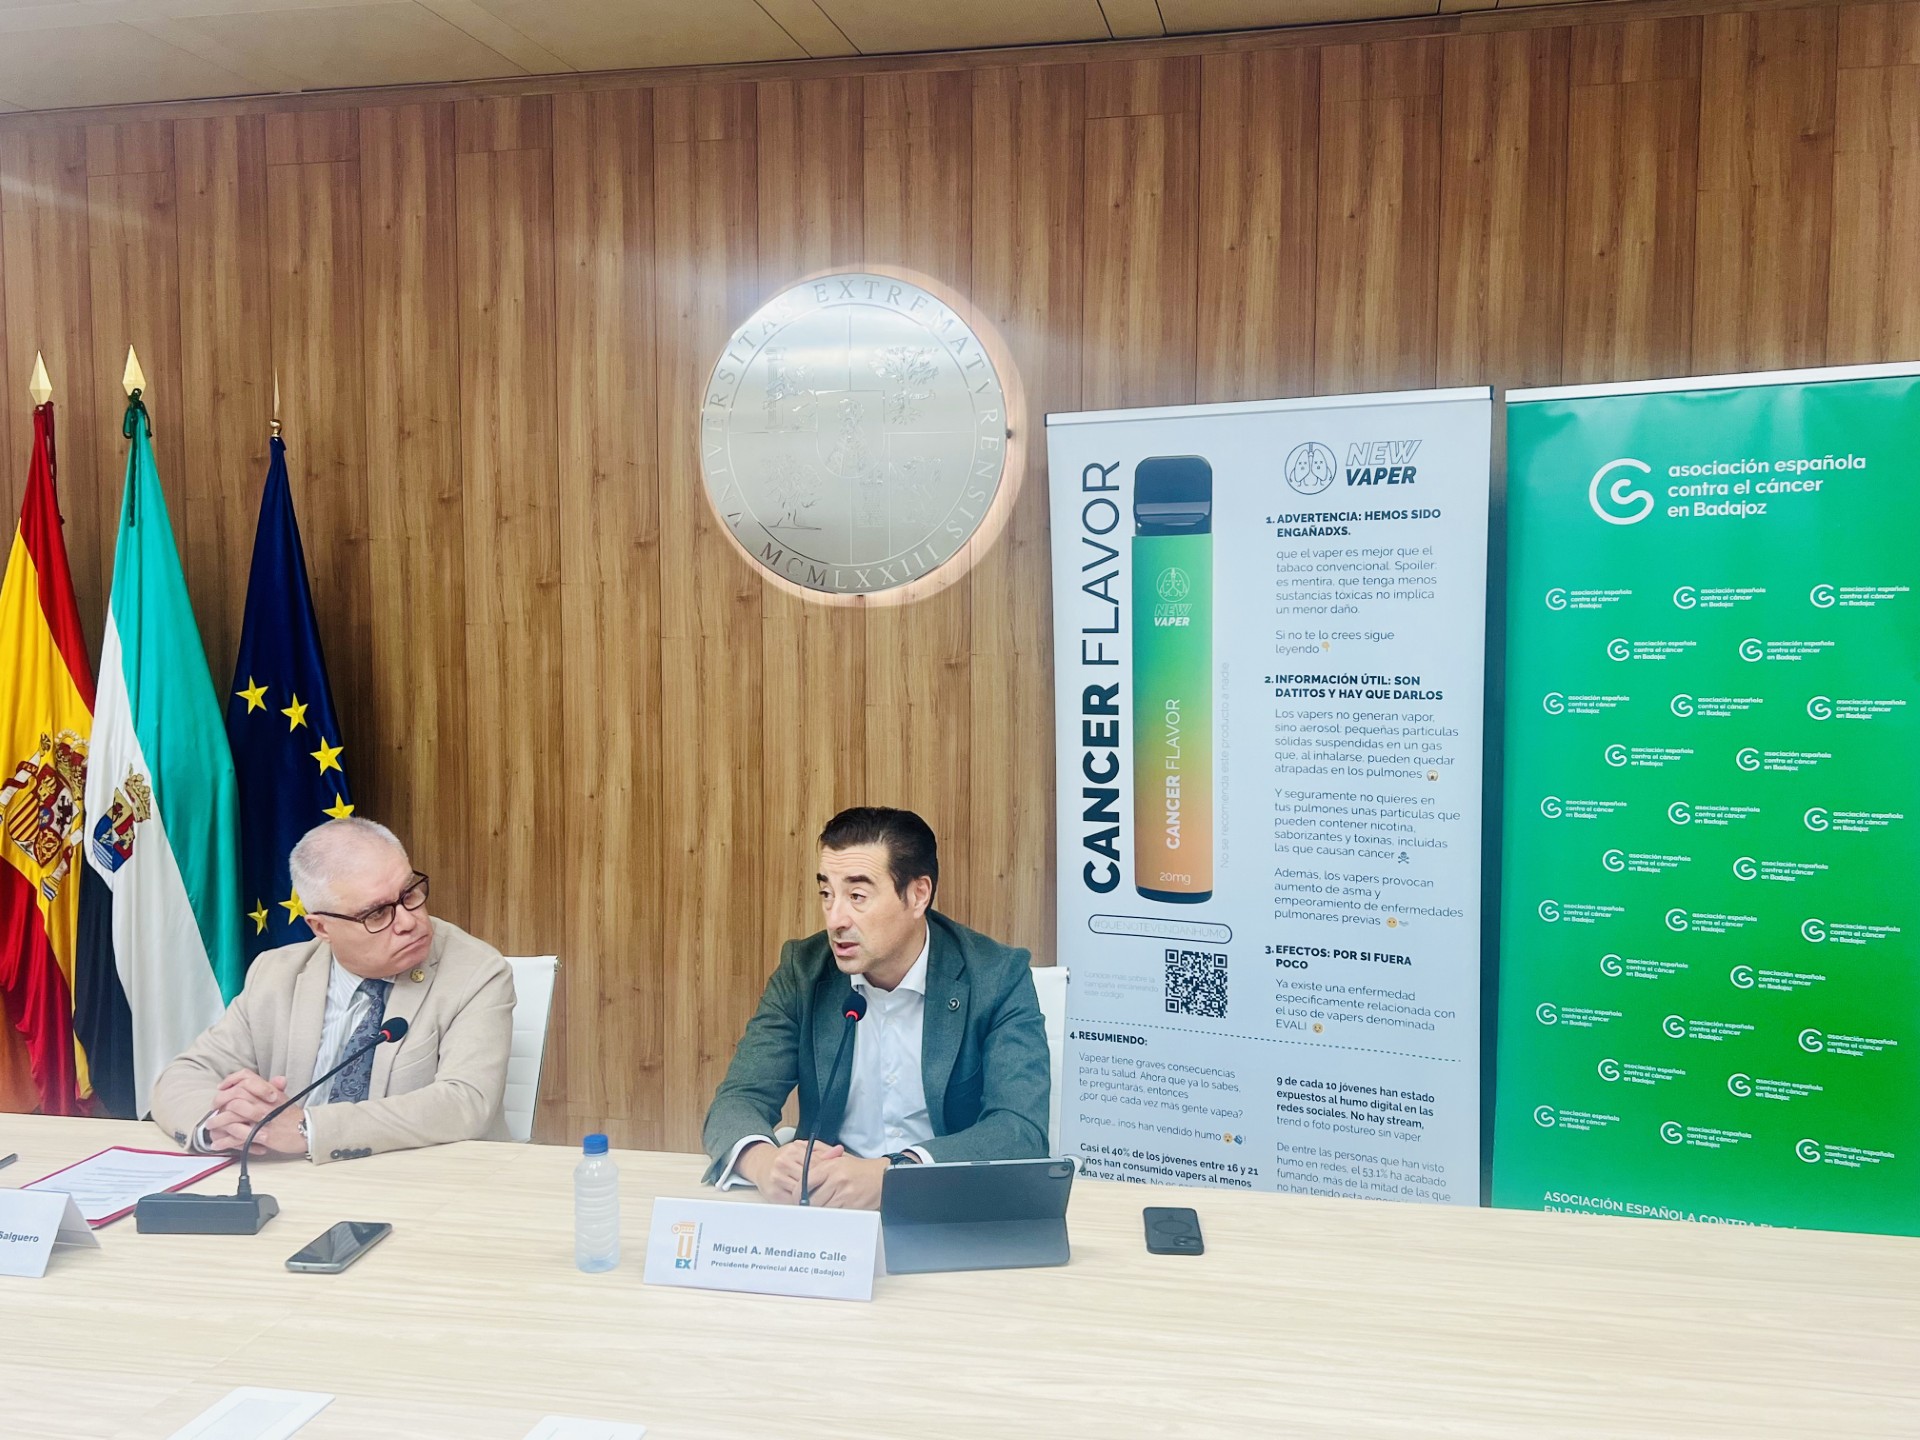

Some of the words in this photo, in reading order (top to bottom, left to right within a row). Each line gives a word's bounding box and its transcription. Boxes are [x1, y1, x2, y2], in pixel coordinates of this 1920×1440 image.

[1345, 440, 1422, 466] NEW
[1668, 458, 1770, 477] asociación
[1774, 454, 1867, 475] española
[1345, 466, 1417, 486] VAPER
[1667, 482, 1728, 498] contra
[1733, 479, 1751, 495] el
[1755, 477, 1823, 494] cáncer
[1276, 512, 1361, 523] ADVERTENCIA:
[1364, 510, 1408, 520] HEMOS
[1410, 509, 1441, 519] SIDO
[1667, 504, 1690, 518] en
[1693, 501, 1767, 519] Badajoz
[1277, 525, 1350, 537] ENGAÑADXS.
[1276, 550, 1297, 560] que
[1300, 547, 1310, 557] el
[1312, 549, 1343, 559] vaper
[1361, 546, 1394, 558] mejor
[1396, 548, 1419, 558] que
[1422, 545, 1432, 555] el
[759, 541, 940, 588] MCMLXXIII
[1082, 461, 1119, 665] FLAVOR
[1276, 562, 1313, 572] tabaco
[1154, 603, 1192, 616] NEW
[1329, 604, 1359, 613] daño.
[1154, 617, 1190, 627] VAPER
[1275, 630, 1285, 639] Si
[1304, 631, 1315, 639] te
[1318, 630, 1328, 639] lo
[1364, 630, 1394, 642] sigue
[1275, 643, 1319, 655] leyendo
[1275, 673, 1357, 684] INFORMACIÓN
[1361, 673, 1391, 685] ÚTIL:
[1394, 676, 1420, 685] SON
[1275, 688, 1325, 698] DATITOS
[1339, 689, 1363, 698] HAY
[1365, 690, 1390, 700] QUE
[1393, 690, 1443, 700] DARLOS
[1165, 699, 1180, 770] FLAVOR
[1082, 682, 1120, 894] CANCER
[1284, 791, 1357, 801] seguramente
[1360, 794, 1373, 802] no
[1376, 793, 1417, 804] quieres
[1166, 775, 1180, 850] CANCER
[1159, 872, 1191, 885] 20mg
[1274, 897, 1361, 910] empeoramiento
[1363, 901, 1378, 911] de
[1380, 903, 1463, 917] enfermedades
[1275, 958, 1308, 969] POCO
[1276, 946, 1330, 959] EFECTOS:
[1333, 950, 1357, 961] POR
[1360, 952, 1370, 962] SI
[1374, 953, 1411, 965] FUERA
[1275, 978, 1288, 988] Ya
[1290, 980, 1322, 992] existe
[1324, 985, 1345, 994] una
[1347, 986, 1415, 1000] enfermedad
[1275, 1019, 1307, 1030] EVALI
[1078, 1030, 1147, 1045] RESUMIENDO:
[1284, 1076, 1297, 1087] de
[1299, 1079, 1323, 1090] cada
[1325, 1083, 1336, 1091] 10
[1338, 1082, 1377, 1096] jóvenes
[1379, 1087, 1398, 1098] han
[1400, 1091, 1434, 1102] estado
[1276, 1090, 1326, 1103] expuestos
[1328, 1094, 1337, 1104] al
[1339, 1095, 1368, 1108] humo
[1370, 1099, 1402, 1112] digital
[1404, 1106, 1416, 1114] en
[1419, 1105, 1433, 1116] las
[1276, 1103, 1304, 1114] redes
[1350, 1111, 1364, 1121] No
[1366, 1112, 1384, 1126] hay
[1386, 1116, 1424, 1130] stream,
[1276, 1115, 1301, 1127] trend
[1311, 1119, 1330, 1131] foto
[1332, 1124, 1375, 1136] postureo
[1378, 1128, 1391, 1138] sin
[1393, 1132, 1421, 1143] vaper
[1080, 1141, 1099, 1153] Casi
[1101, 1145, 1110, 1154] el
[1111, 1147, 1130, 1157] 40%
[1132, 1148, 1144, 1159] de
[1146, 1150, 1160, 1162] los
[1161, 1153, 1197, 1167] jóvenes
[1199, 1160, 1225, 1171] entre
[1227, 1163, 1238, 1173] 16
[1247, 1167, 1258, 1176] 21
[1084, 1155, 1102, 1166] ños
[1103, 1157, 1120, 1168] han
[1122, 1162, 1173, 1176] consumido
[1174, 1169, 1206, 1181] vapers
[1208, 1172, 1217, 1182] al
[1219, 1176, 1251, 1187] menos
[1544, 1191, 1623, 1212] ASOCIACIÓN
[1626, 1202, 1697, 1223] ESPAÑOLA
[0, 1230, 39, 1244] Salguero
[712, 1243, 748, 1255] Miguel
[750, 1246, 762, 1255] A.
[765, 1246, 816, 1260] Mendiano
[819, 1251, 847, 1262] Calle
[711, 1260, 749, 1270] Presidente
[751, 1263, 787, 1272] Provincial
[788, 1266, 809, 1274] AACC
[810, 1267, 845, 1278] (Badajoz)
